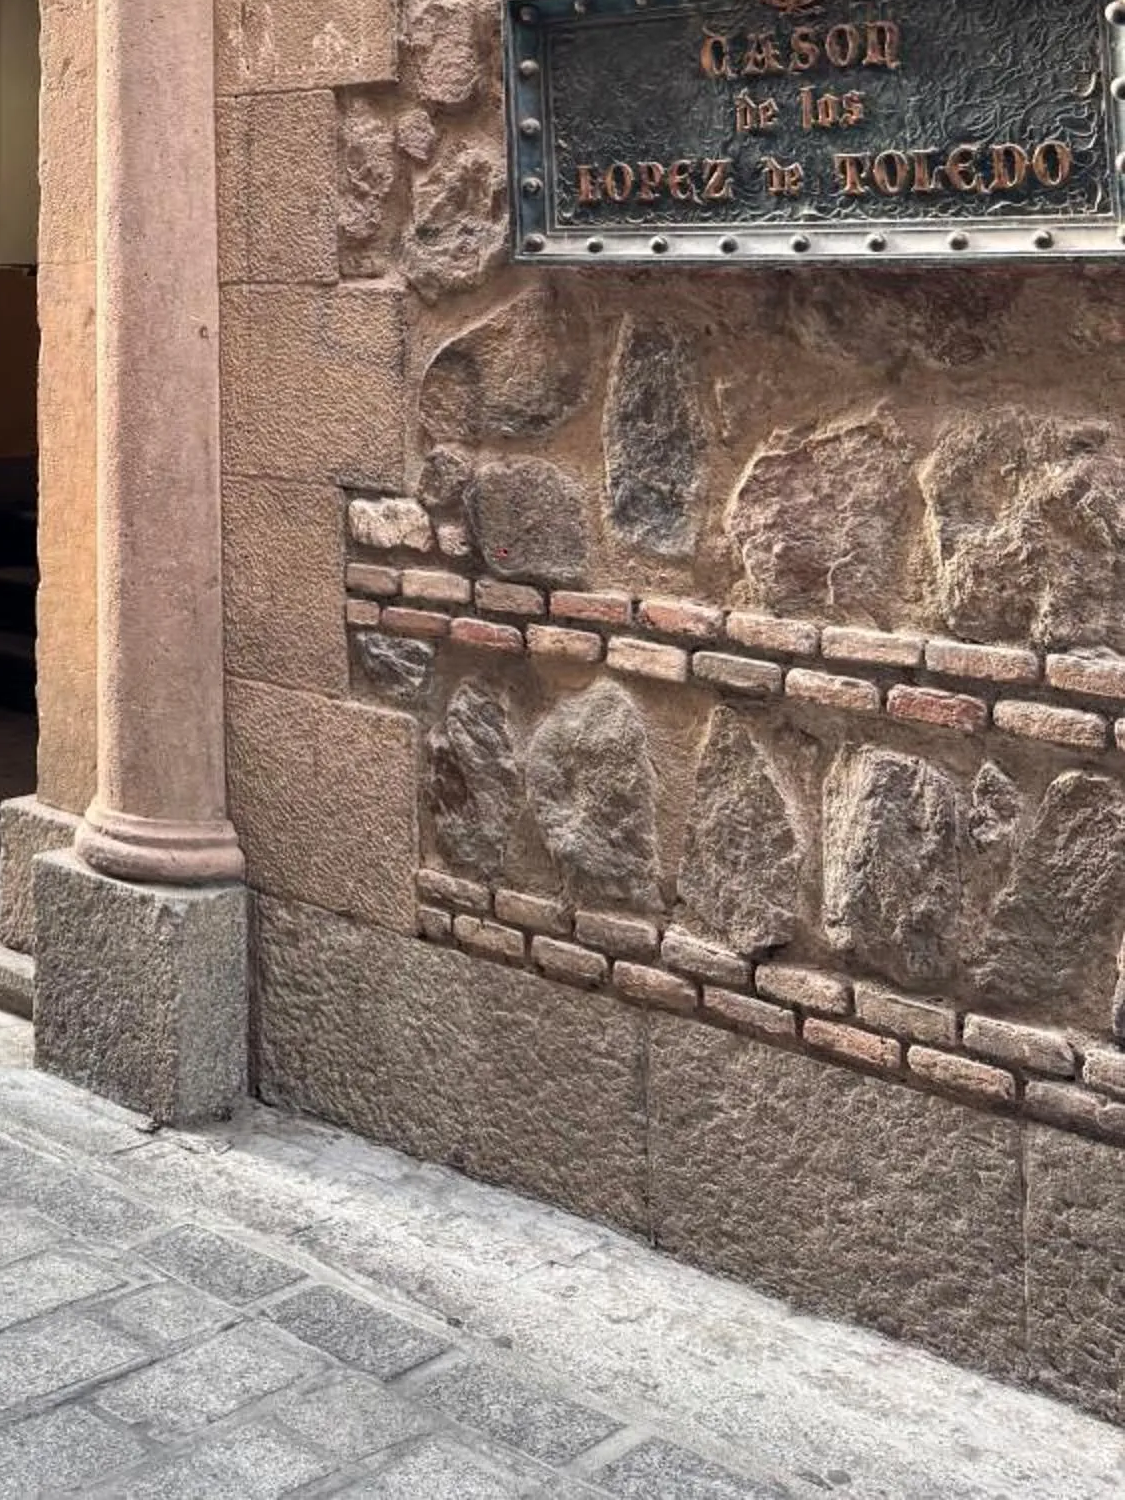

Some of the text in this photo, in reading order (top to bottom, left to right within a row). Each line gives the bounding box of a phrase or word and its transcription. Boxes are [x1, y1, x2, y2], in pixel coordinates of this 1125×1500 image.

[700, 18, 901, 80] CASON
[735, 86, 866, 132] de los
[577, 139, 1073, 204] LOPEZ de TOLEDO
